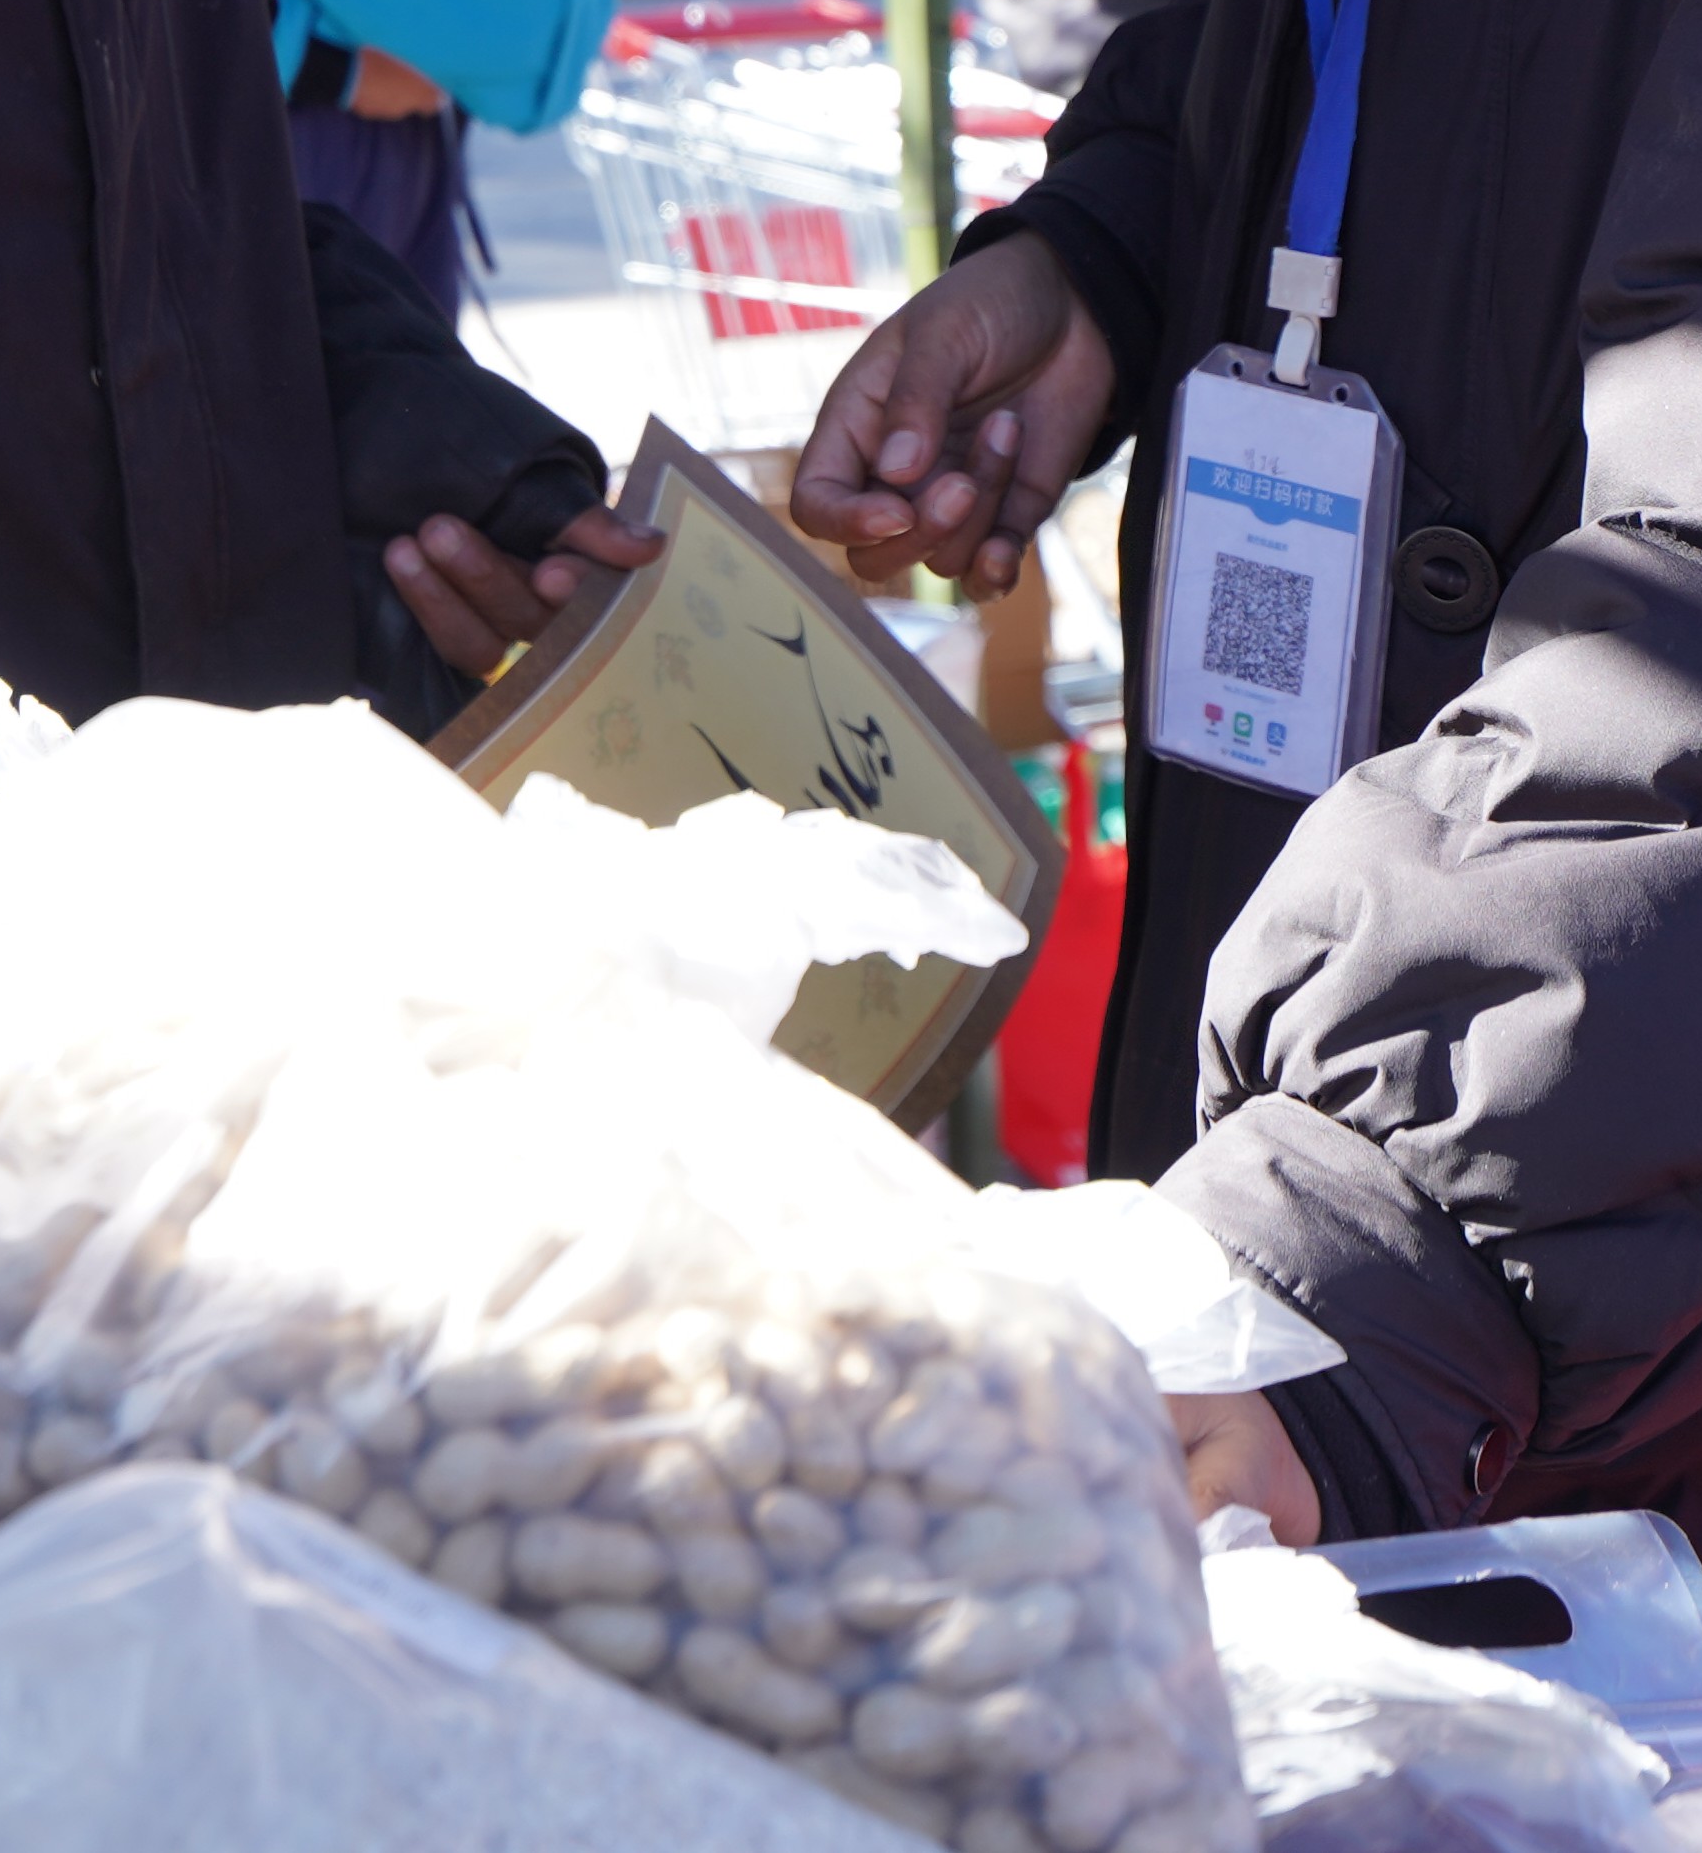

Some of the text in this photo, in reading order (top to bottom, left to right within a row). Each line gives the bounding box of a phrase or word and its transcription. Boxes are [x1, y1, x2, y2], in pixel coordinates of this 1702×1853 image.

[1211, 465, 1334, 518] 欢迎扫码付款
